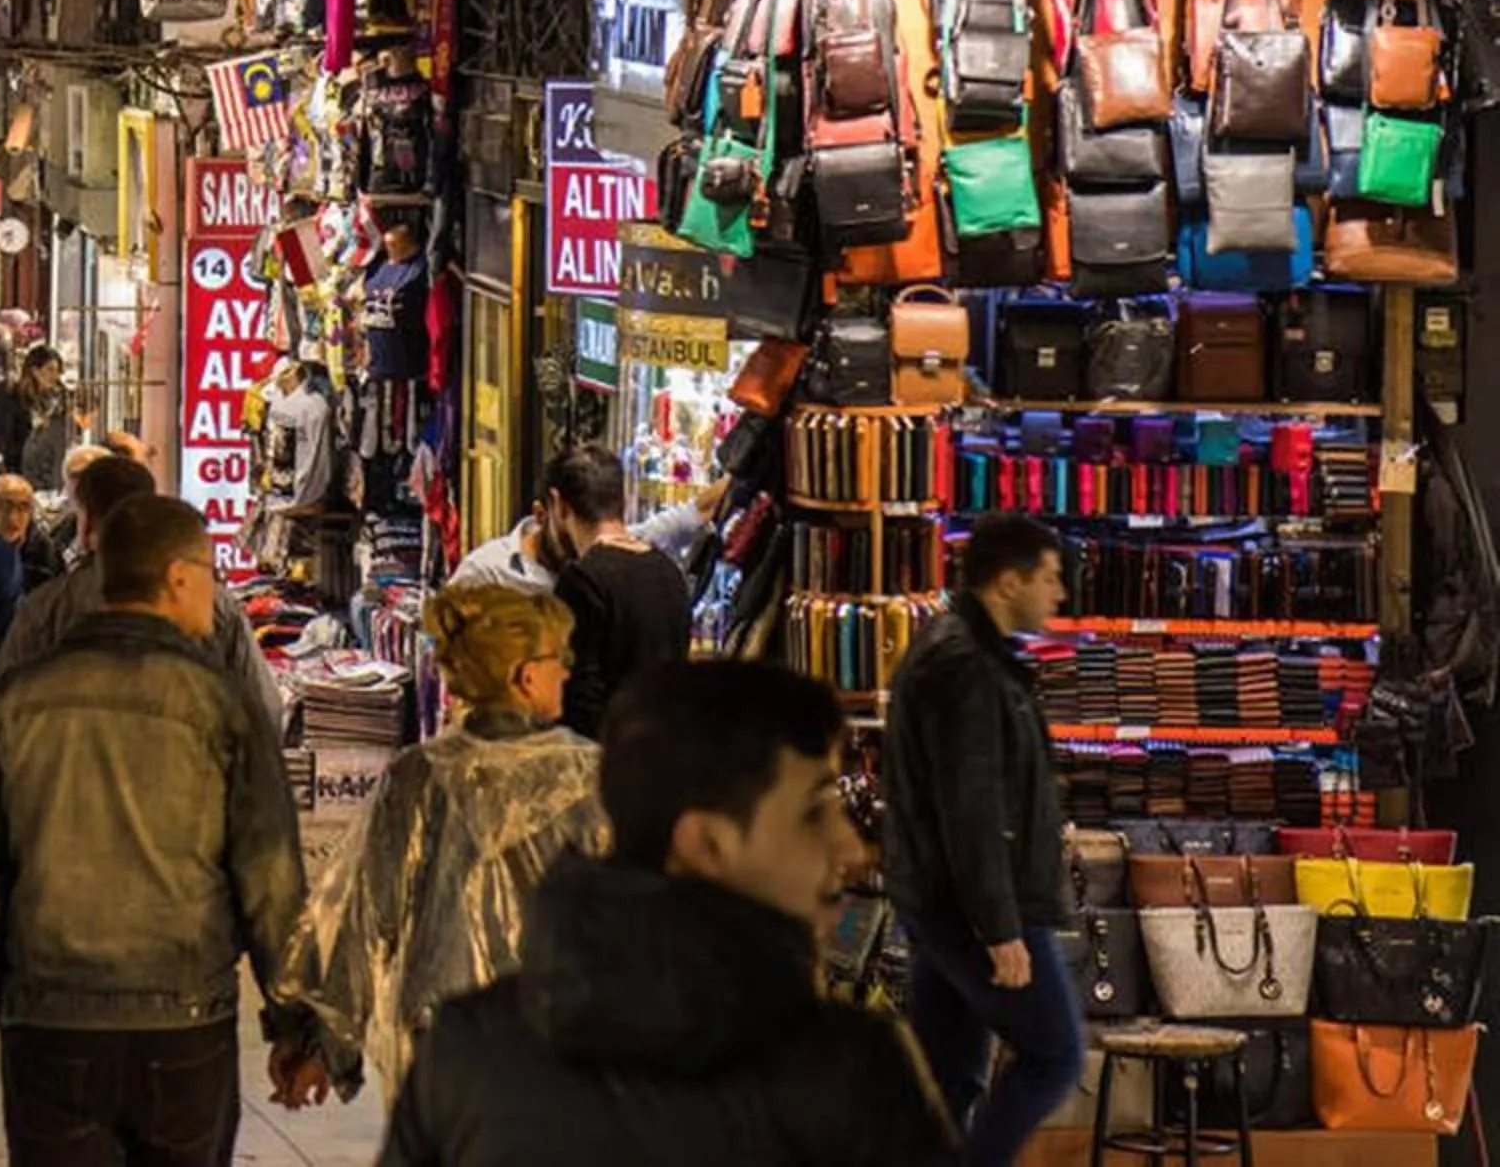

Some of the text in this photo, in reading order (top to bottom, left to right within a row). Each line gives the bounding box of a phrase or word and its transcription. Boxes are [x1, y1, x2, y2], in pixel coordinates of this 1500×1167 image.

[563, 172, 645, 220] ALTIN
[196, 257, 227, 278] 14
[557, 237, 622, 285] ALIN
[189, 400, 250, 441] AL
[198, 453, 247, 484] GÜ
